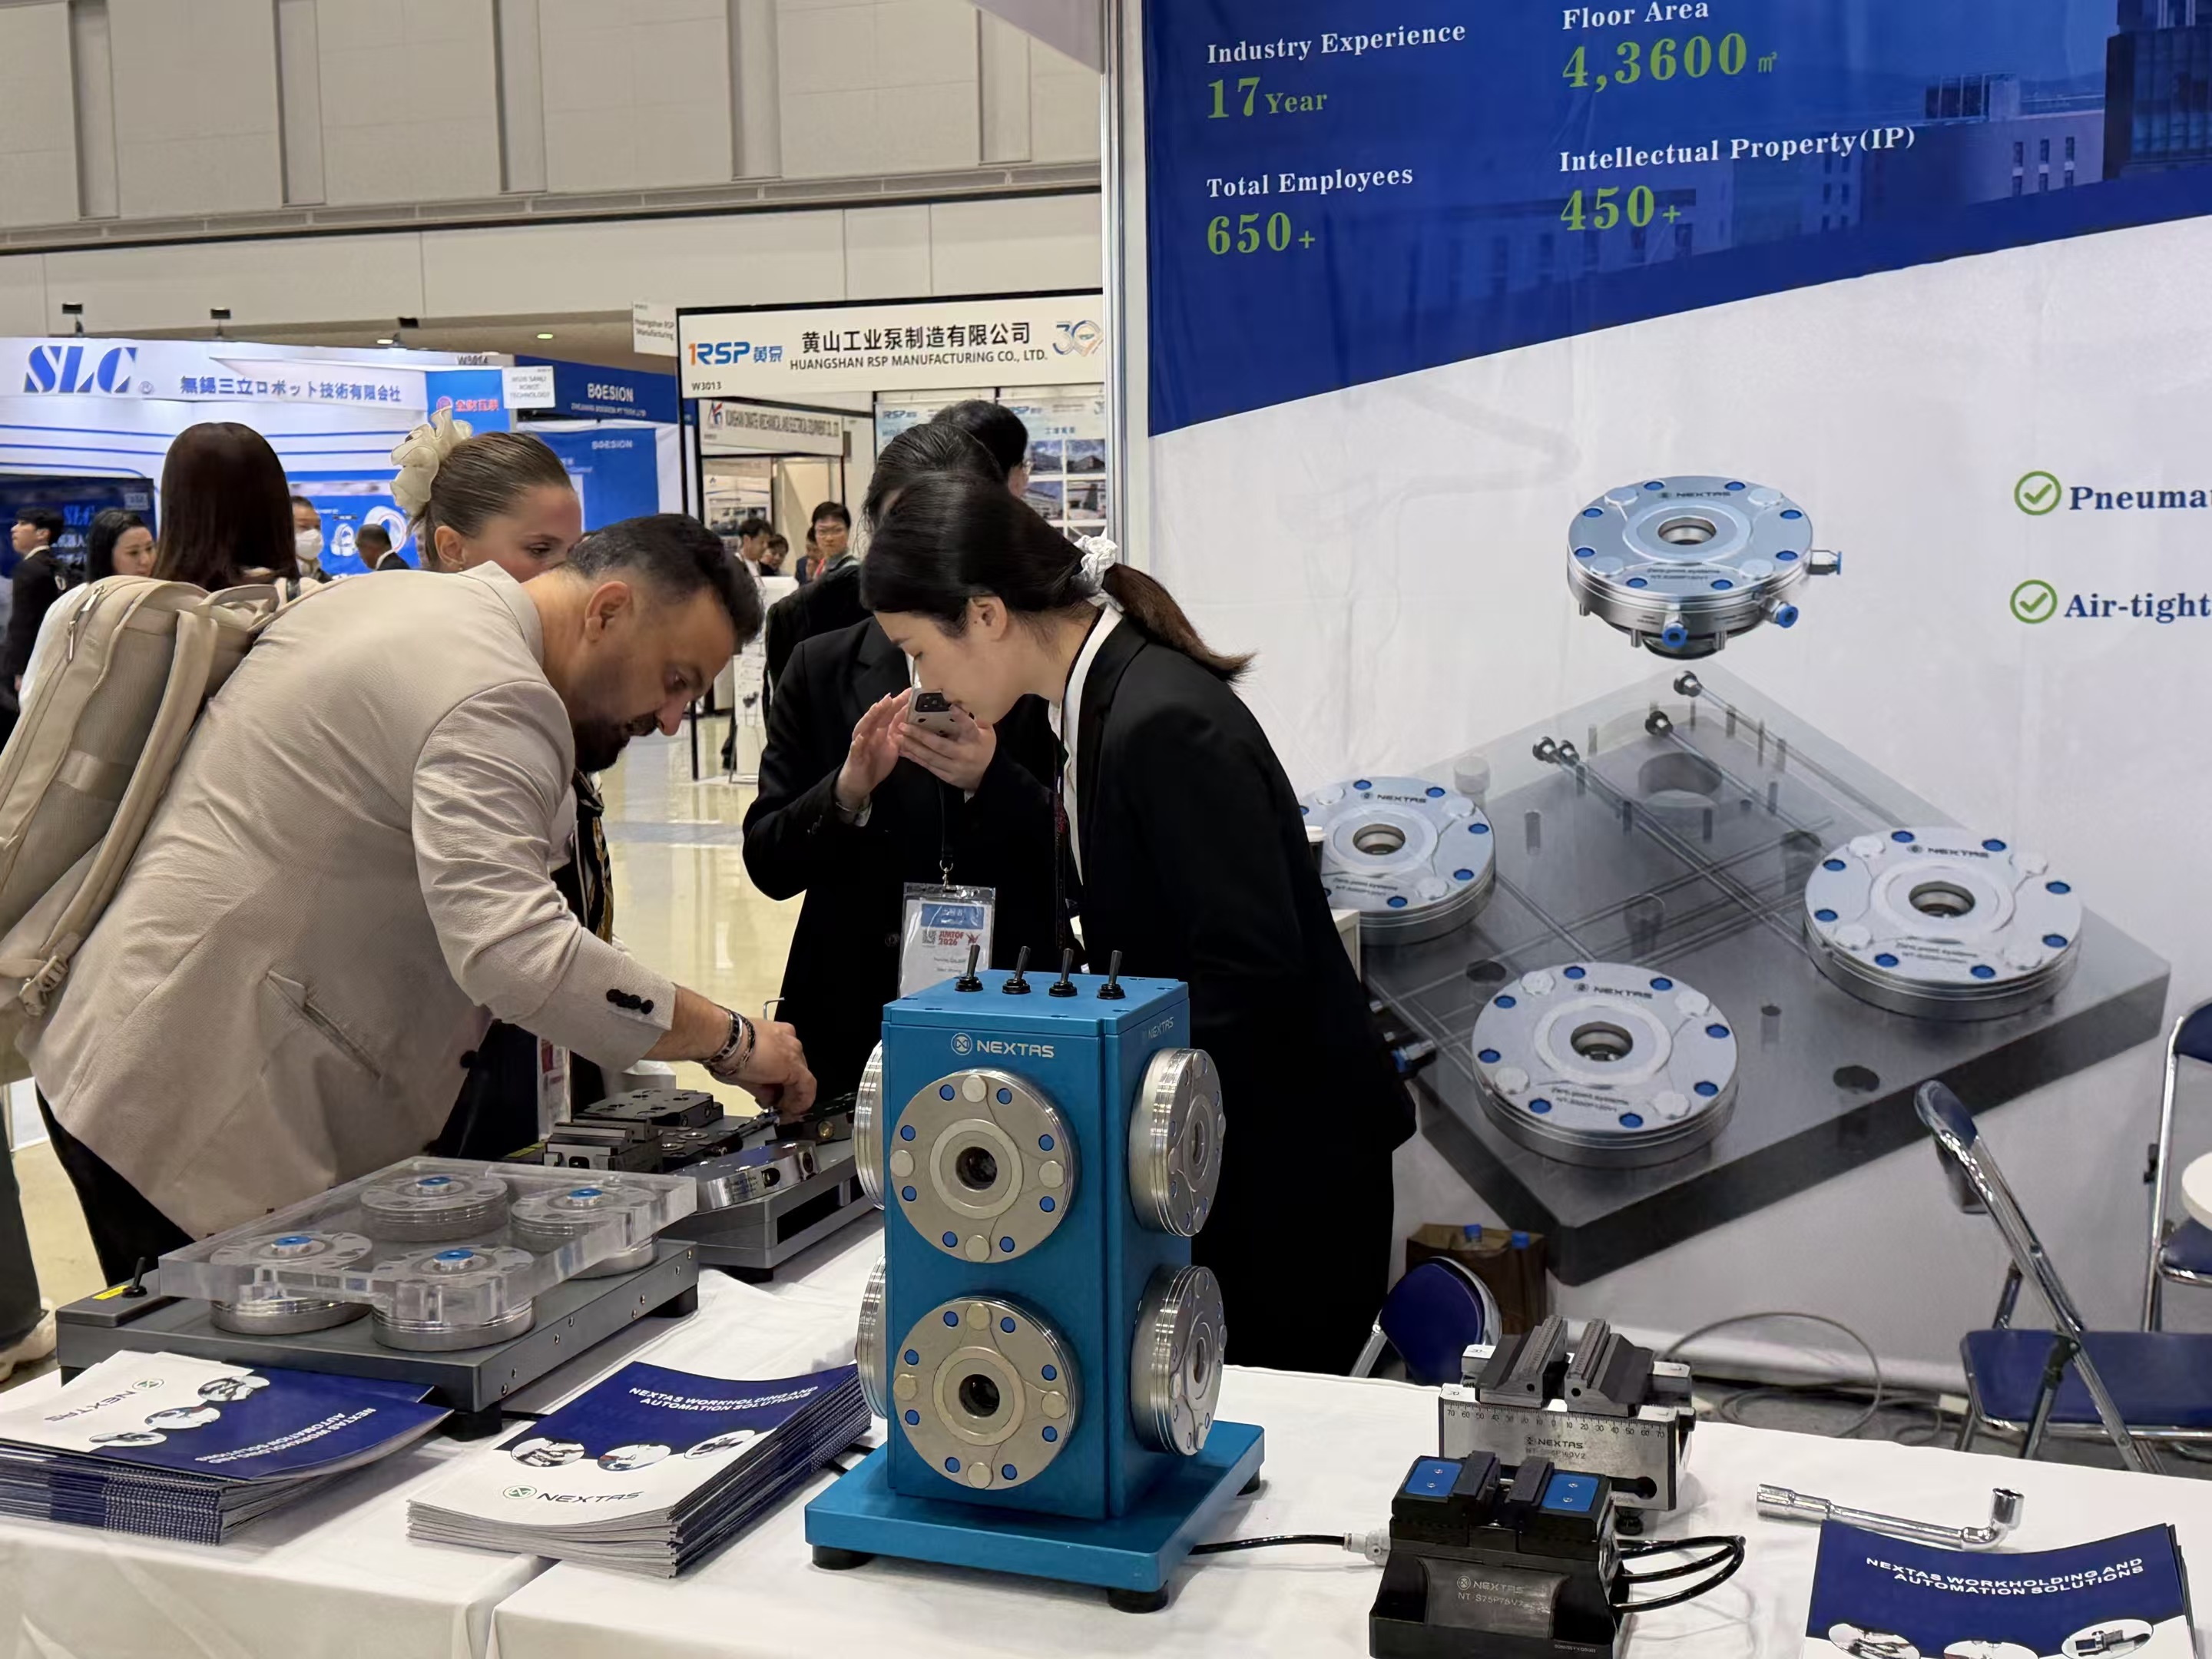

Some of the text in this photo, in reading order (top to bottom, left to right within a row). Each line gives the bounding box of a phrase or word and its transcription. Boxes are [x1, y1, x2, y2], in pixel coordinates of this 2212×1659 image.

[1562, 1, 1709, 30] Floor Area
[1207, 25, 1466, 64] Industry Experience
[1562, 32, 1747, 93] 4,3600
[1560, 126, 1916, 172] Intellectual Property(IP)
[1207, 168, 1413, 197] Total Employees
[1560, 185, 1682, 230] 450+
[1207, 212, 1316, 255] 650+
[802, 322, 1031, 353] 黄山工业泵制造有限公司
[23, 346, 138, 393] SLC
[790, 349, 1048, 370] HUANGSHAN RSP MANUFACTURING CO., LTD.
[587, 382, 634, 402] BOESION
[691, 381, 722, 391] W3013
[2069, 486, 2212, 510] Pneuma
[1377, 794, 1426, 803] NEXTAS
[1928, 847, 1989, 858] NEXTAS
[1593, 986, 1653, 999] NEXTAS
[976, 1039, 1055, 1058] NEXTAS
[629, 1387, 684, 1402] NEXTAS
[640, 1392, 812, 1411] AUTOMATION SOLUTIONS
[1538, 1438, 1584, 1449] NEXTAS
[536, 1491, 644, 1503] NEXTAS
[1866, 1558, 2143, 1588] NEXTAS WORKHOLDING AND
[1894, 1566, 2144, 1595] AUTOMATION SOLUTIONS
